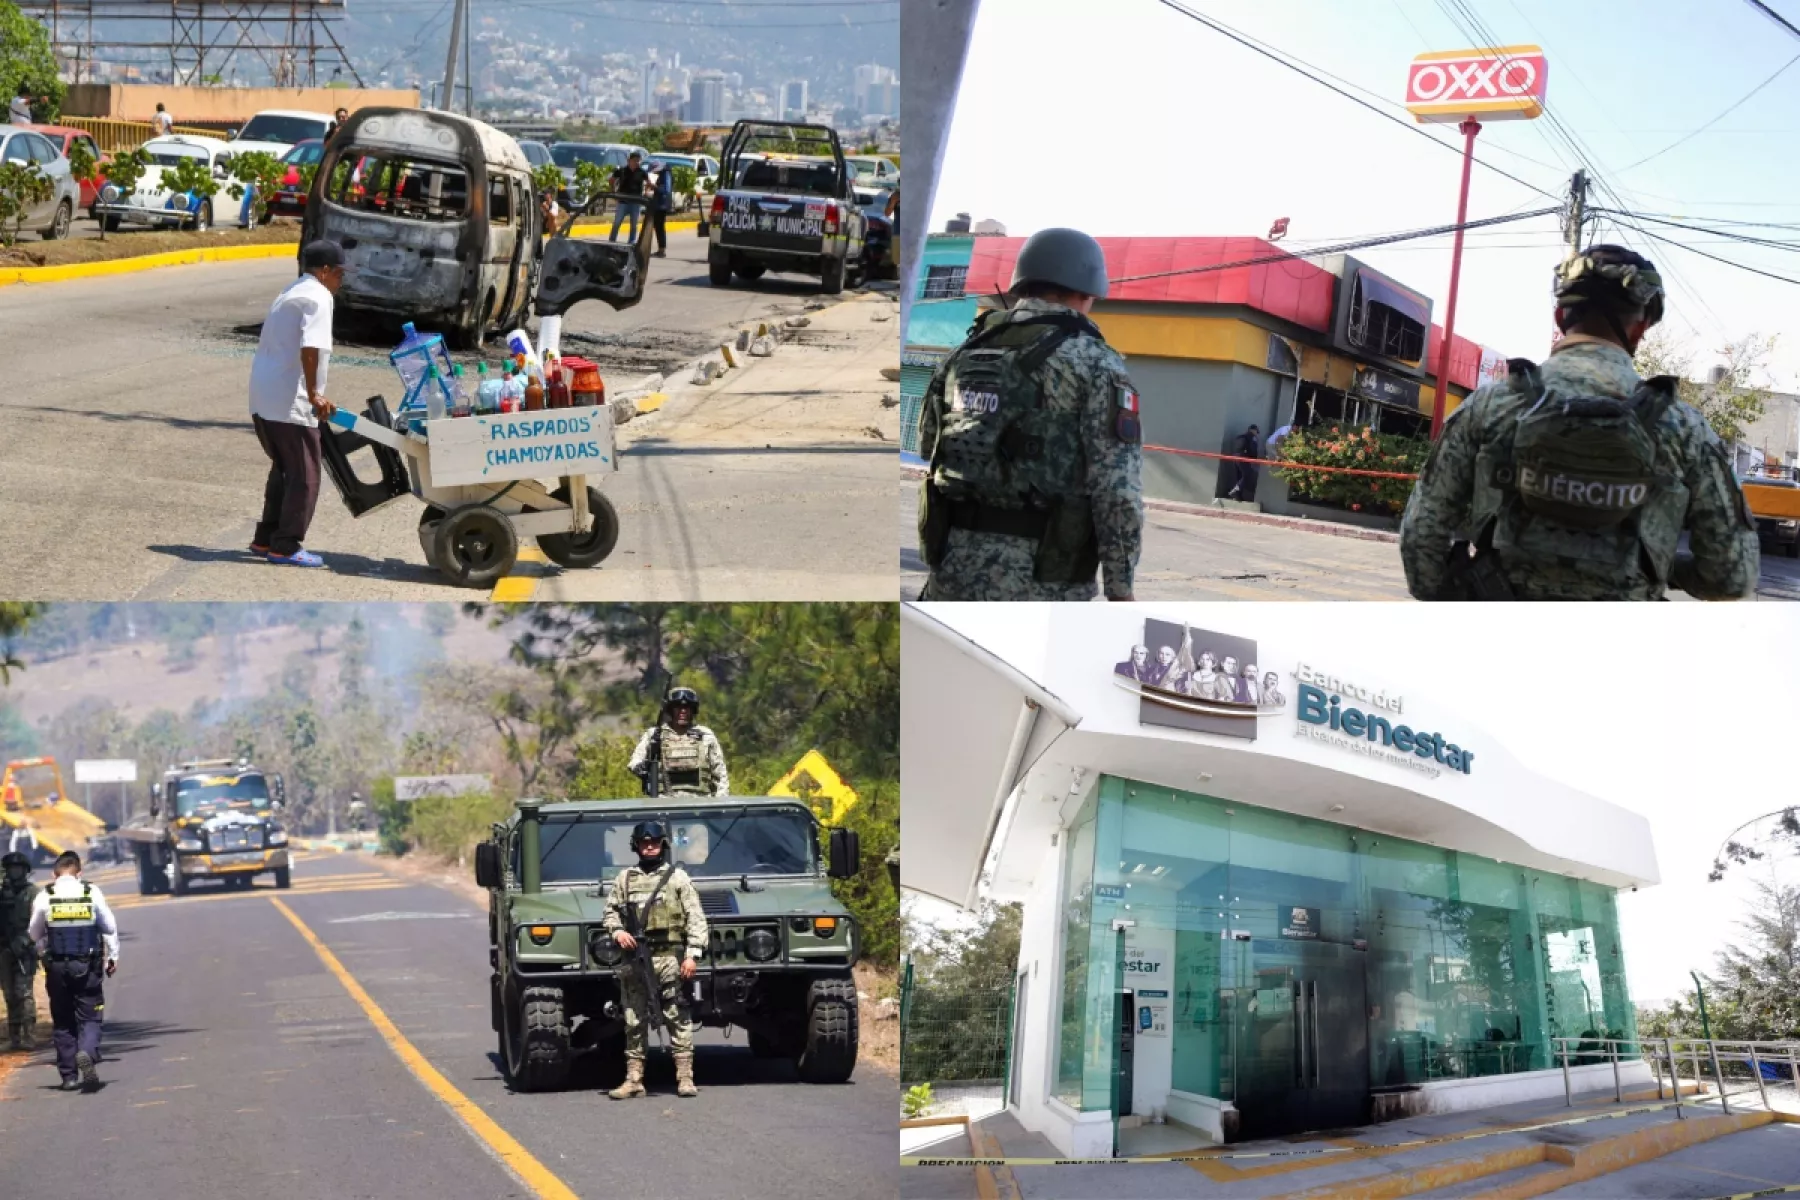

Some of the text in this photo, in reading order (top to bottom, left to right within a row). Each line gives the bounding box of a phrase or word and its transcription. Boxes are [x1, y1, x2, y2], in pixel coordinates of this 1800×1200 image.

[1412, 59, 1536, 100] OXXO
[776, 216, 823, 236] MUNICIPAL
[491, 417, 591, 440] RASPADOS
[486, 441, 600, 466] CHAMOYADAS
[1520, 467, 1648, 508] EJÉRCITO
[1297, 662, 1404, 715] Banco del
[1297, 683, 1475, 775] Bienestar
[1099, 886, 1121, 896] ATM
[1119, 959, 1161, 973] estar
